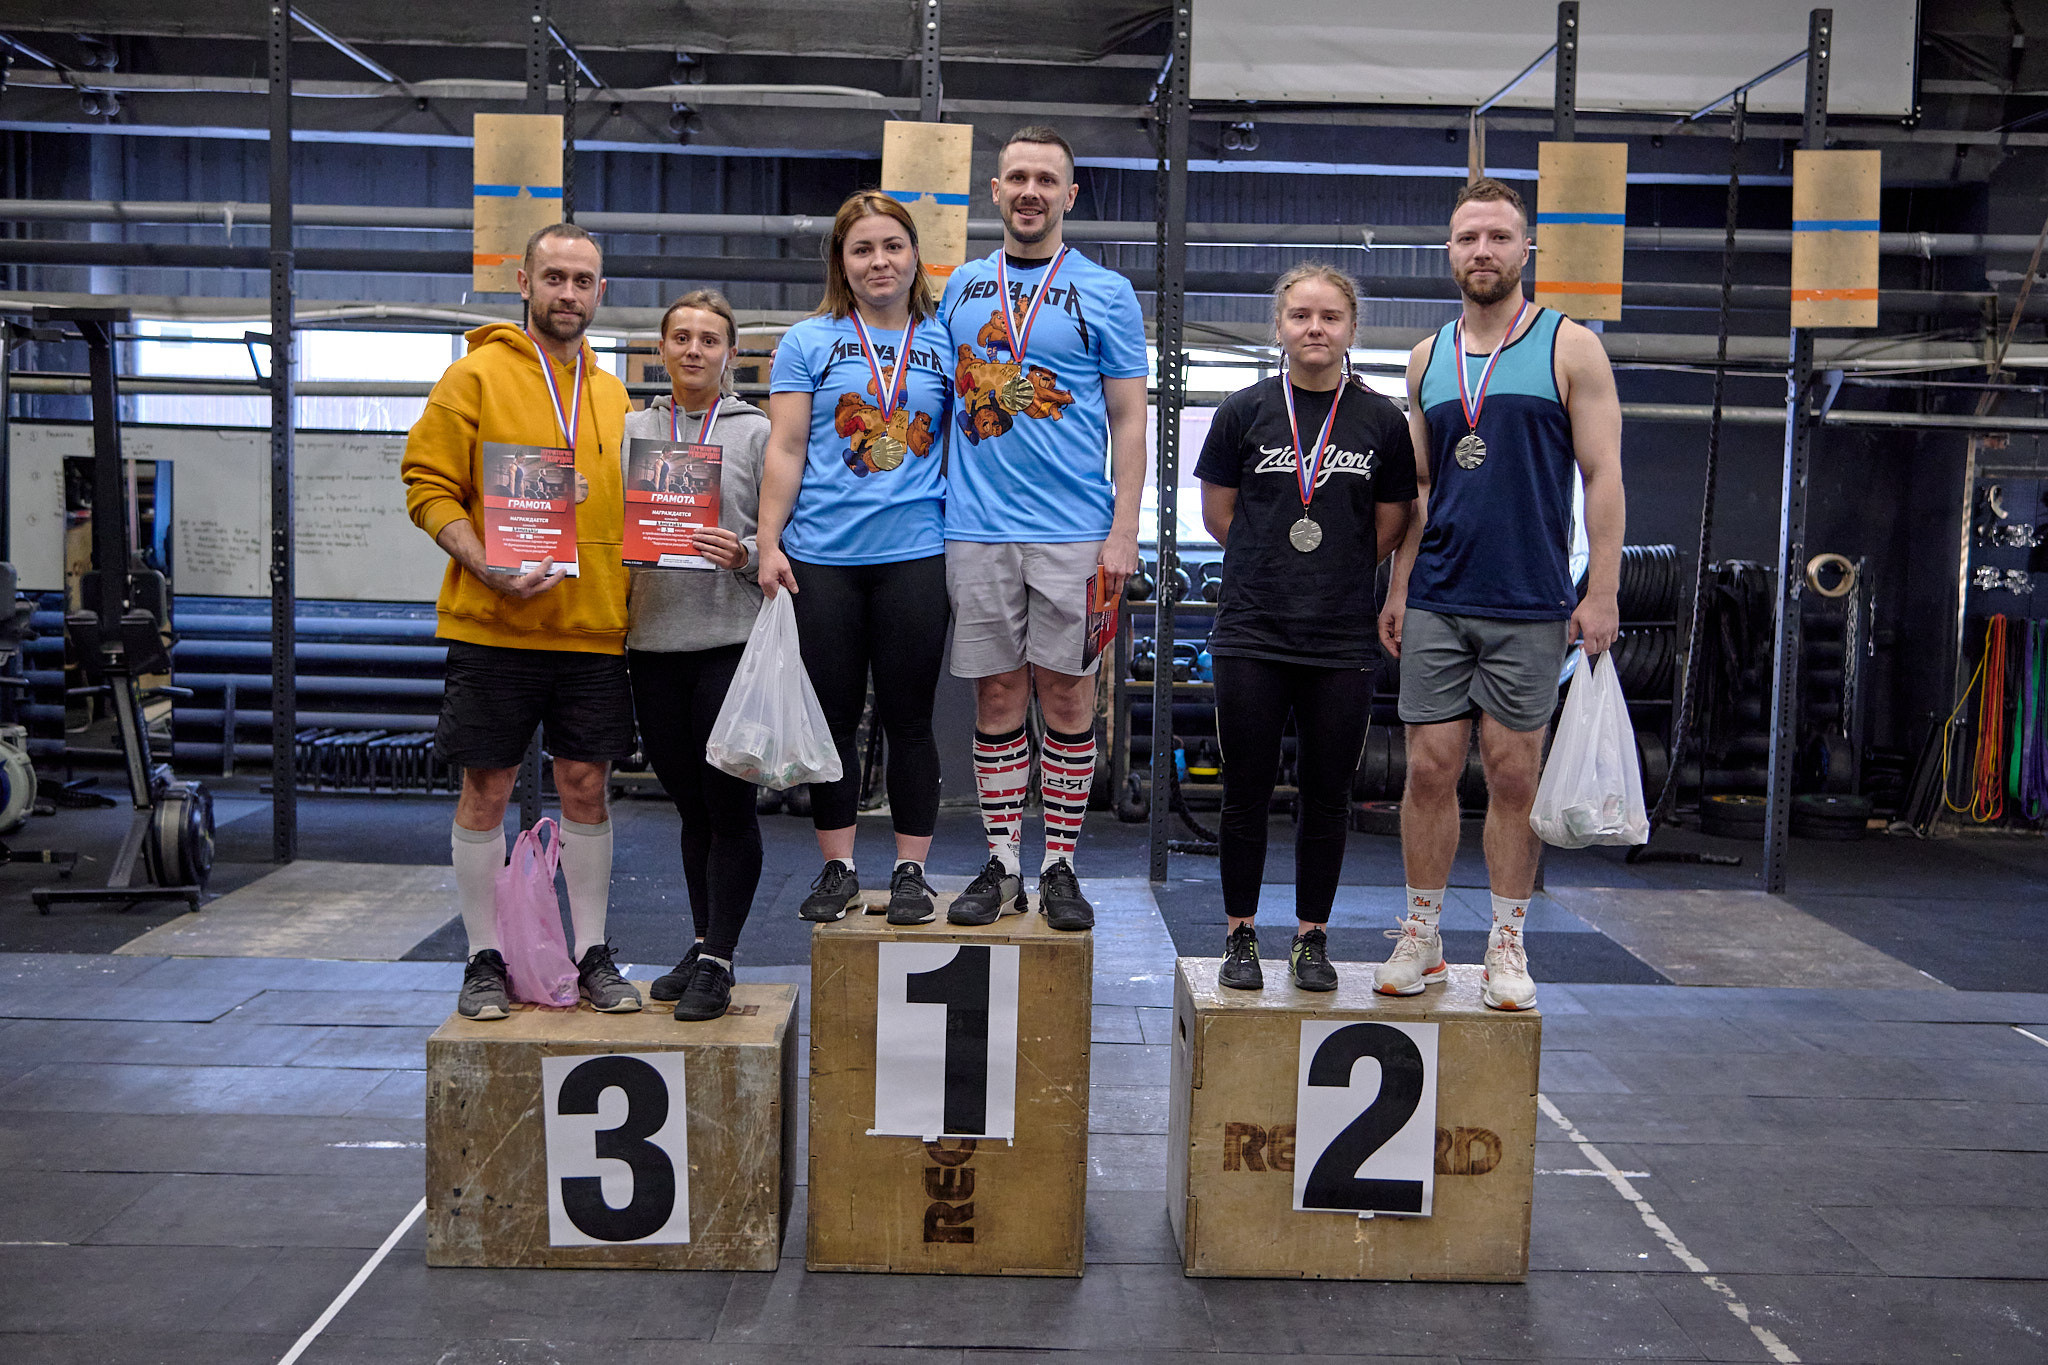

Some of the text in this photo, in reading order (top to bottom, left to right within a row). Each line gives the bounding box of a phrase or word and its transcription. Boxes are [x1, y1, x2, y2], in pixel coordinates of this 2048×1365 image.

[508, 499, 552, 510] ГРАМОТА
[651, 493, 695, 504] ГРАМОТА
[906, 945, 991, 1136] 1
[1302, 1022, 1424, 1213] 2
[557, 1055, 676, 1242] 3
